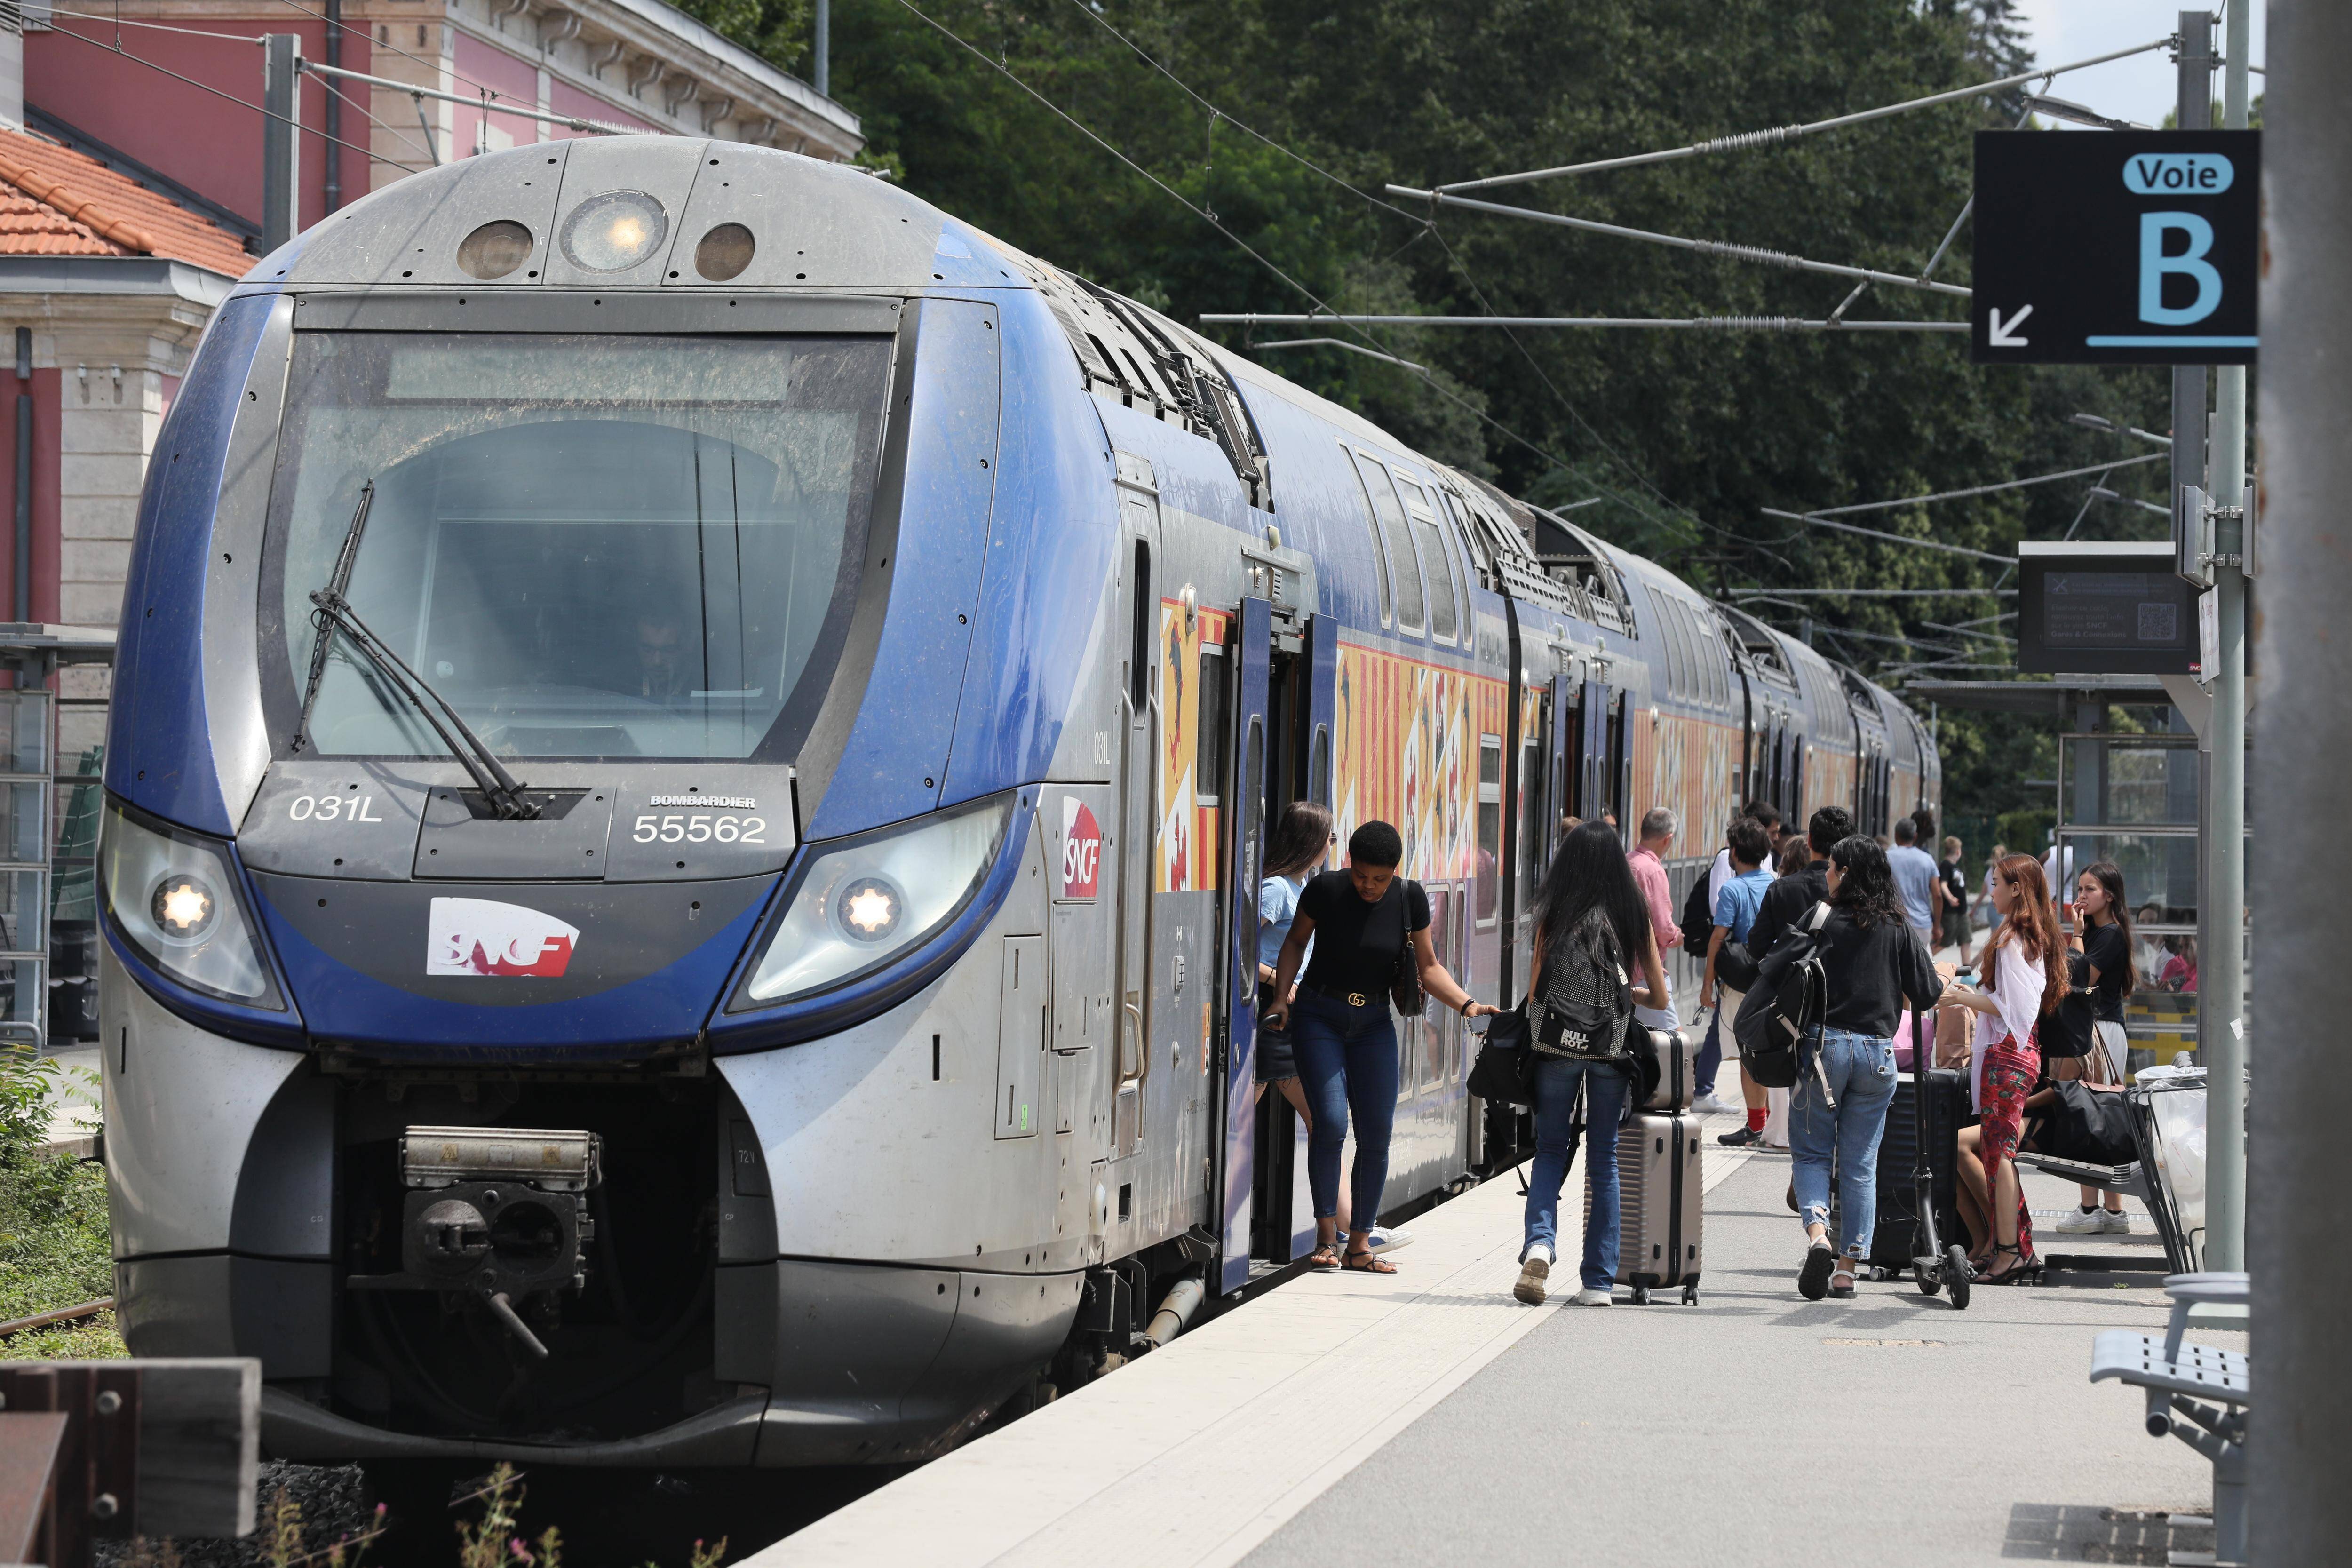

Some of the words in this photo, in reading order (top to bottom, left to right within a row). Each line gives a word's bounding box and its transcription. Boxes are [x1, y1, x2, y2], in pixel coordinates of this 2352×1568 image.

[2137, 159, 2218, 189] Voie
[2139, 211, 2223, 326] B
[1094, 731, 1110, 764] 031L
[290, 796, 382, 822] 031L
[650, 795, 755, 809] BOMBARDIER
[633, 815, 766, 844] 55562
[1065, 838, 1099, 884] SNCF
[436, 931, 569, 966] SNCF
[1560, 1036, 1583, 1049] ROT
[1562, 1028, 1589, 1043] BULL
